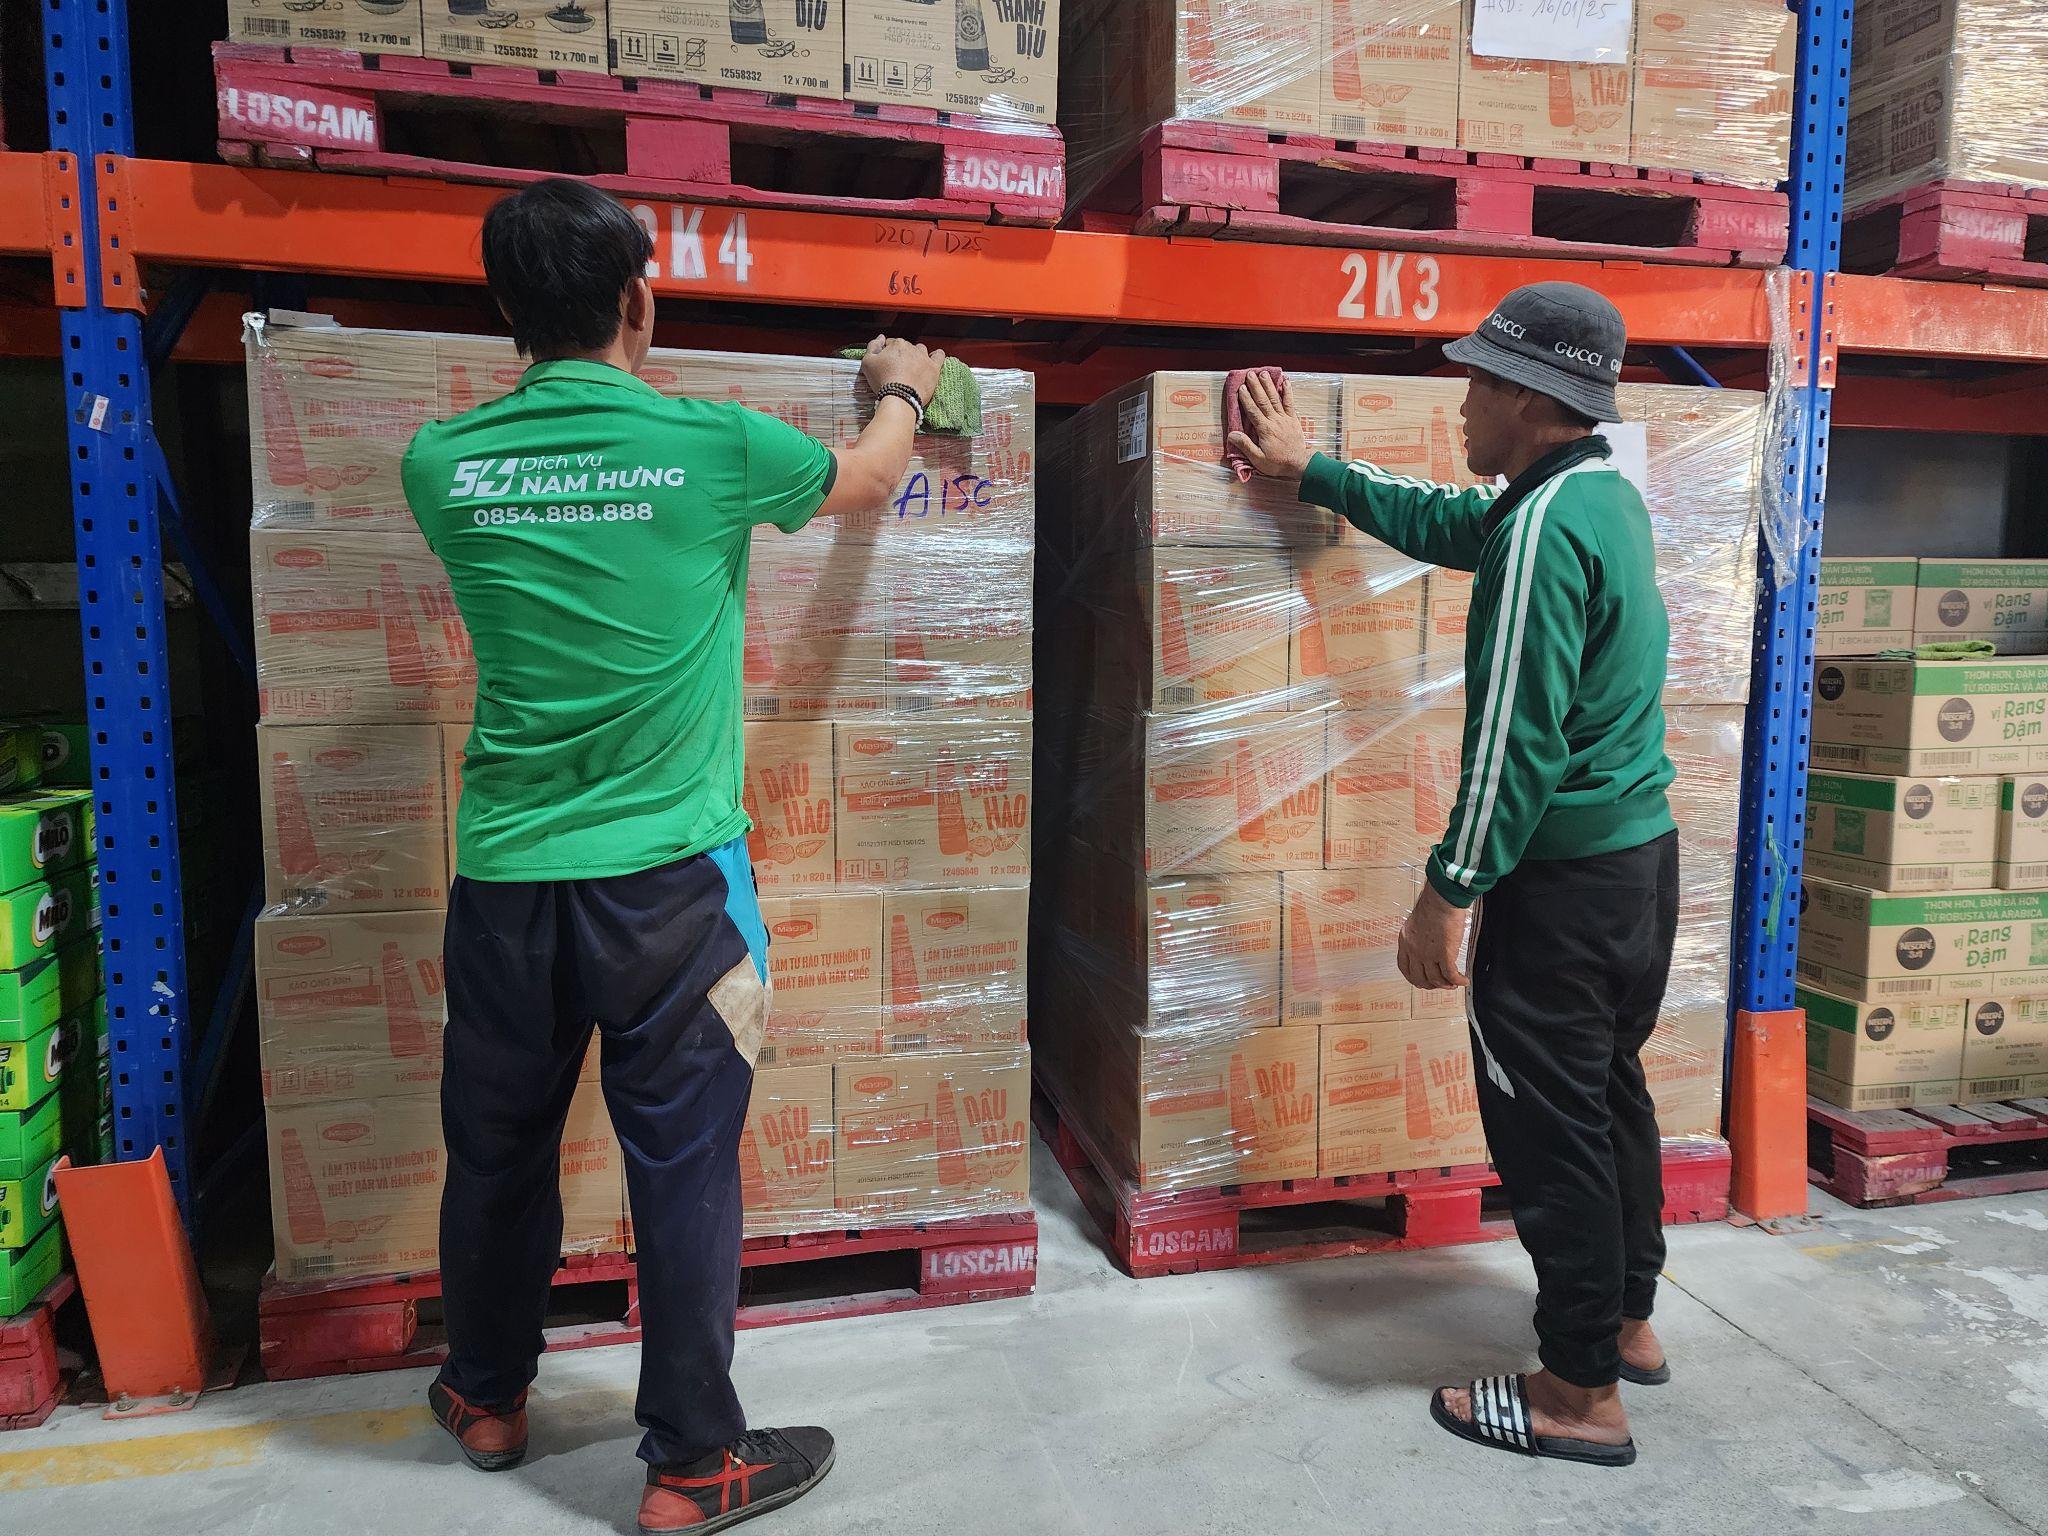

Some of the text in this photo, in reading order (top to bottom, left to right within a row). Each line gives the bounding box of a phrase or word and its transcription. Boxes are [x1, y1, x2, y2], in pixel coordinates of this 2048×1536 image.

[299, 27, 347, 41] 12558332
[358, 32, 369, 43] 12
[380, 34, 397, 45] 700
[493, 44, 539, 58] 12558332
[570, 51, 586, 63] 700
[588, 54, 599, 64] ml
[720, 67, 829, 89] 12558332 12 700 ml
[227, 87, 374, 142] LOSCAM
[1020, 101, 1035, 113] 700
[945, 155, 1062, 198] LOSCAM
[1491, 312, 1527, 340] GUCCI
[1554, 341, 1604, 368] GUCCI
[520, 453, 604, 474] Dịch Vụ
[520, 466, 686, 495] NAM HƯNG
[473, 503, 654, 527] 0854.888.888
[1995, 592, 2032, 608] Rang
[1993, 609, 2028, 629] Đậm
[1979, 682, 2021, 692] ROBUSTA
[2004, 697, 2046, 718] Rang
[2003, 720, 2042, 741] Đậm
[760, 759, 810, 803] DẦU
[783, 798, 831, 837] HÀO
[983, 793, 1027, 830] HÀO
[39, 825, 69, 853] MILO
[809, 872, 825, 882] 820
[39, 908, 69, 932] MILO
[1939, 910, 1986, 922] ROBUSTA
[2001, 908, 2044, 919] ARABICA
[777, 924, 812, 934] Maggi
[1967, 925, 2013, 946] Rang
[1966, 947, 2008, 968] Đậm
[1254, 1060, 1296, 1099] DẦU
[1428, 1051, 1468, 1088] DẦU
[963, 1088, 1008, 1128] DẦU
[1272, 1091, 1313, 1129] HÀO
[760, 1104, 810, 1148] DẦU
[783, 1138, 831, 1178] HÀO
[1135, 1226, 1235, 1257] LOSCAM
[929, 1246, 1036, 1278] LOSCAM
